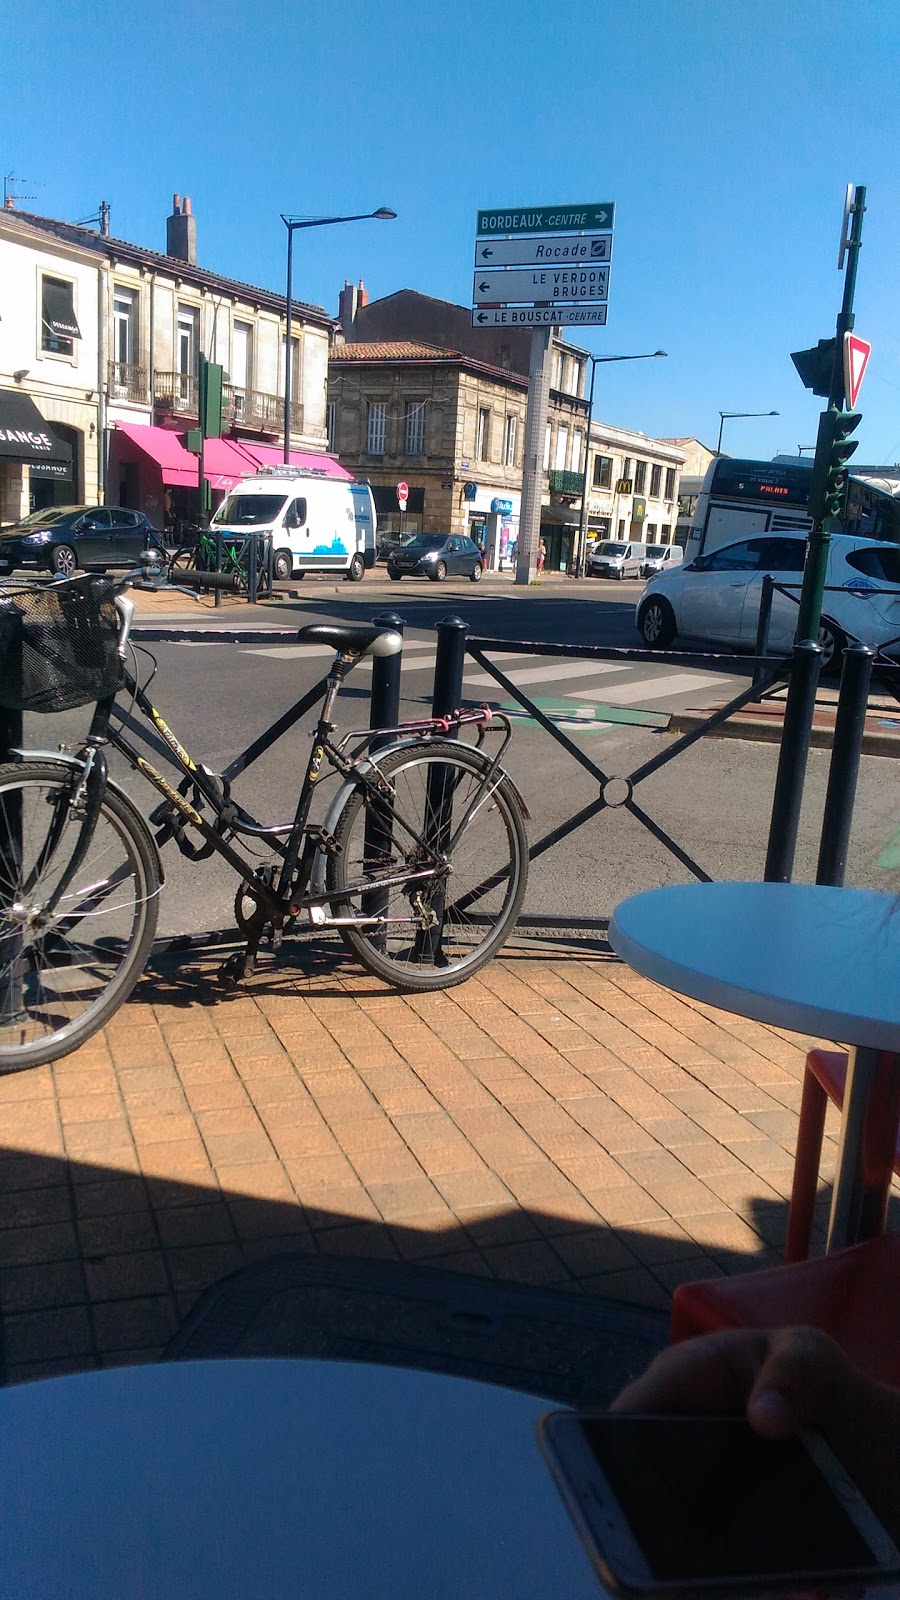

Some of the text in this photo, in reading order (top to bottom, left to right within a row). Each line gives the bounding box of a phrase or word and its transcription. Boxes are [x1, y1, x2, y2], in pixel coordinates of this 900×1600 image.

[481, 213, 543, 229] BORDEAUX
[536, 243, 587, 257] Rocade
[532, 271, 606, 284] LE VERDON
[553, 285, 604, 297] BRUGES
[494, 312, 507, 322] LE
[512, 311, 563, 322] BOUSCAT
[52, 320, 79, 332] DESSANGE
[760, 485, 788, 494] PALAIS
